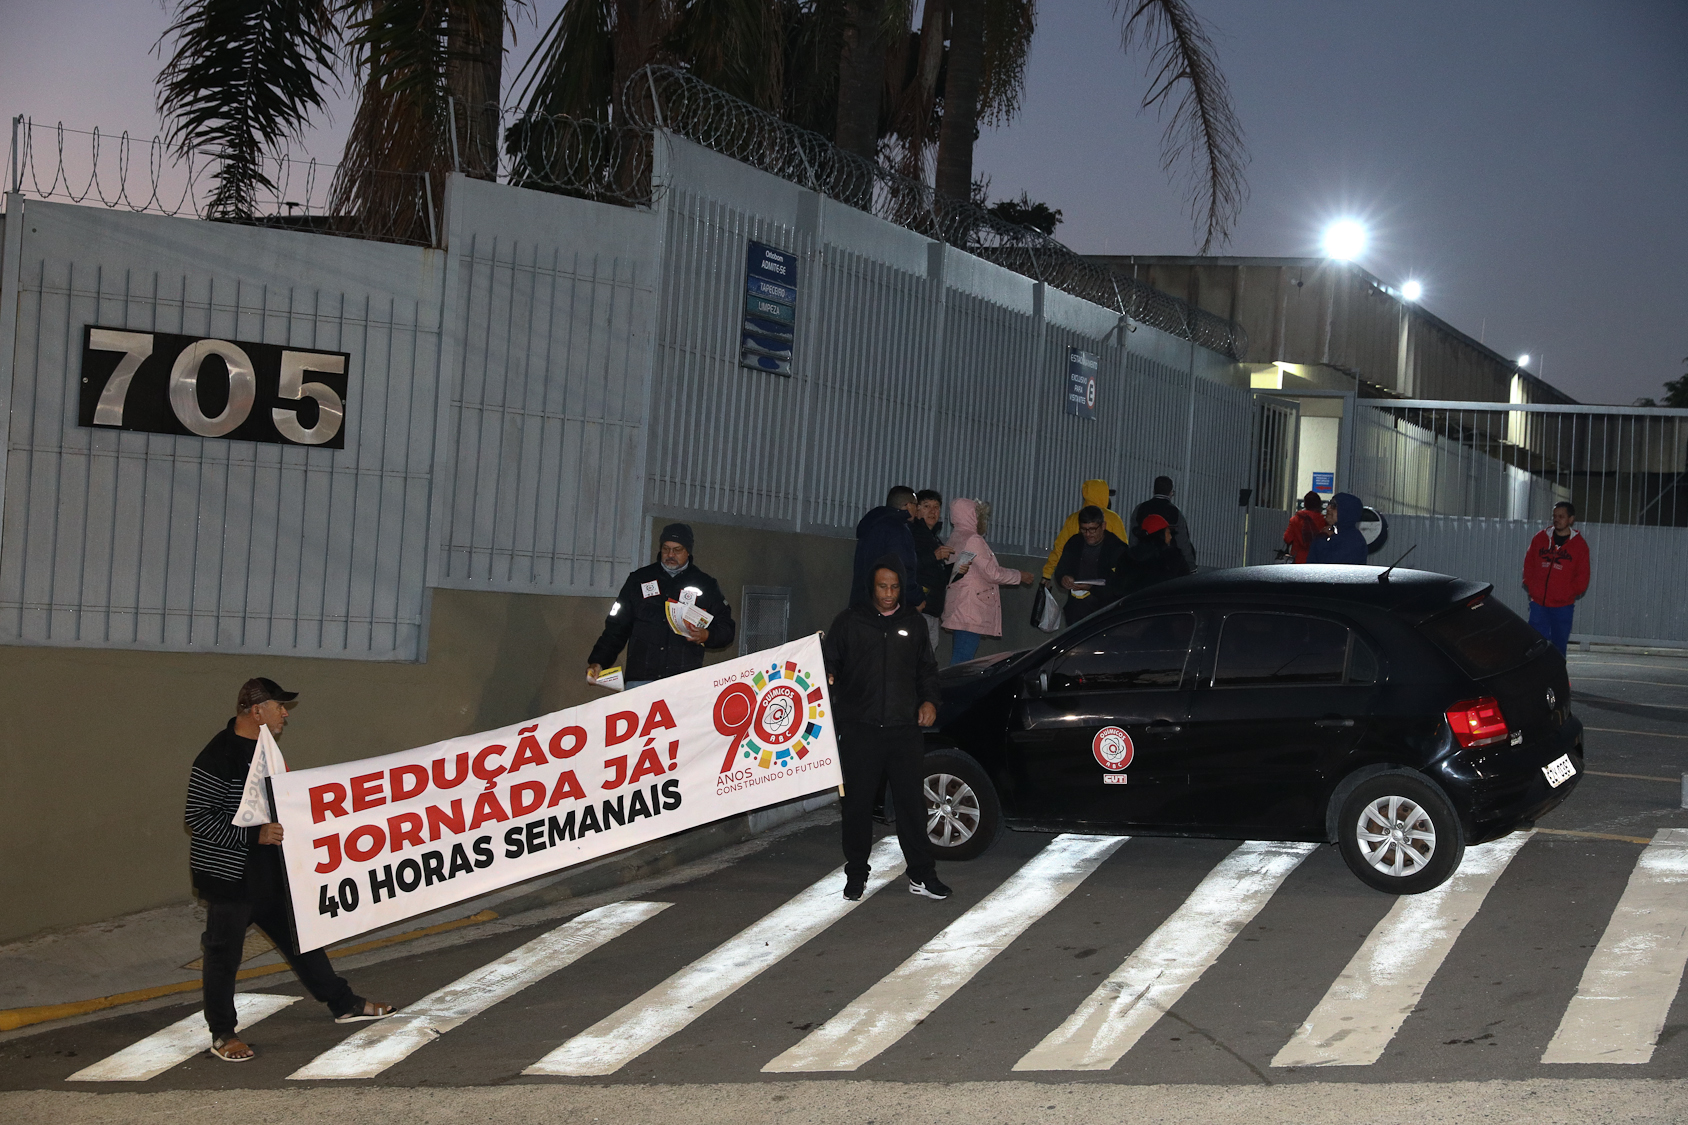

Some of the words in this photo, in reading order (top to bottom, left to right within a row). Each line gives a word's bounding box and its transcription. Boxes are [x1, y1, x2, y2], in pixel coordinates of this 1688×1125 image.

[761, 259, 787, 276] ADMITE-SE
[760, 282, 786, 298] TAPECEIRO
[758, 301, 780, 315] LIMPEZA
[89, 328, 345, 444] 705
[1071, 374, 1087, 384] EXCLUSIVO
[1074, 385, 1083, 393] PARA
[713, 674, 738, 688] RUMO
[740, 668, 756, 679] AOS
[762, 687, 795, 707] QUÍMICOS
[309, 724, 588, 825] REDUÇÃO
[605, 699, 678, 748] DA
[716, 771, 784, 796] CONSTRUINDO
[786, 768, 794, 777] O
[795, 757, 832, 774] FUTURO
[716, 767, 754, 787] ANOS
[313, 769, 588, 874] JORNADA
[601, 737, 680, 790] JÁ!
[318, 877, 360, 919] 40
[368, 835, 495, 905] HORAS
[504, 778, 682, 860] SEMANAIS
